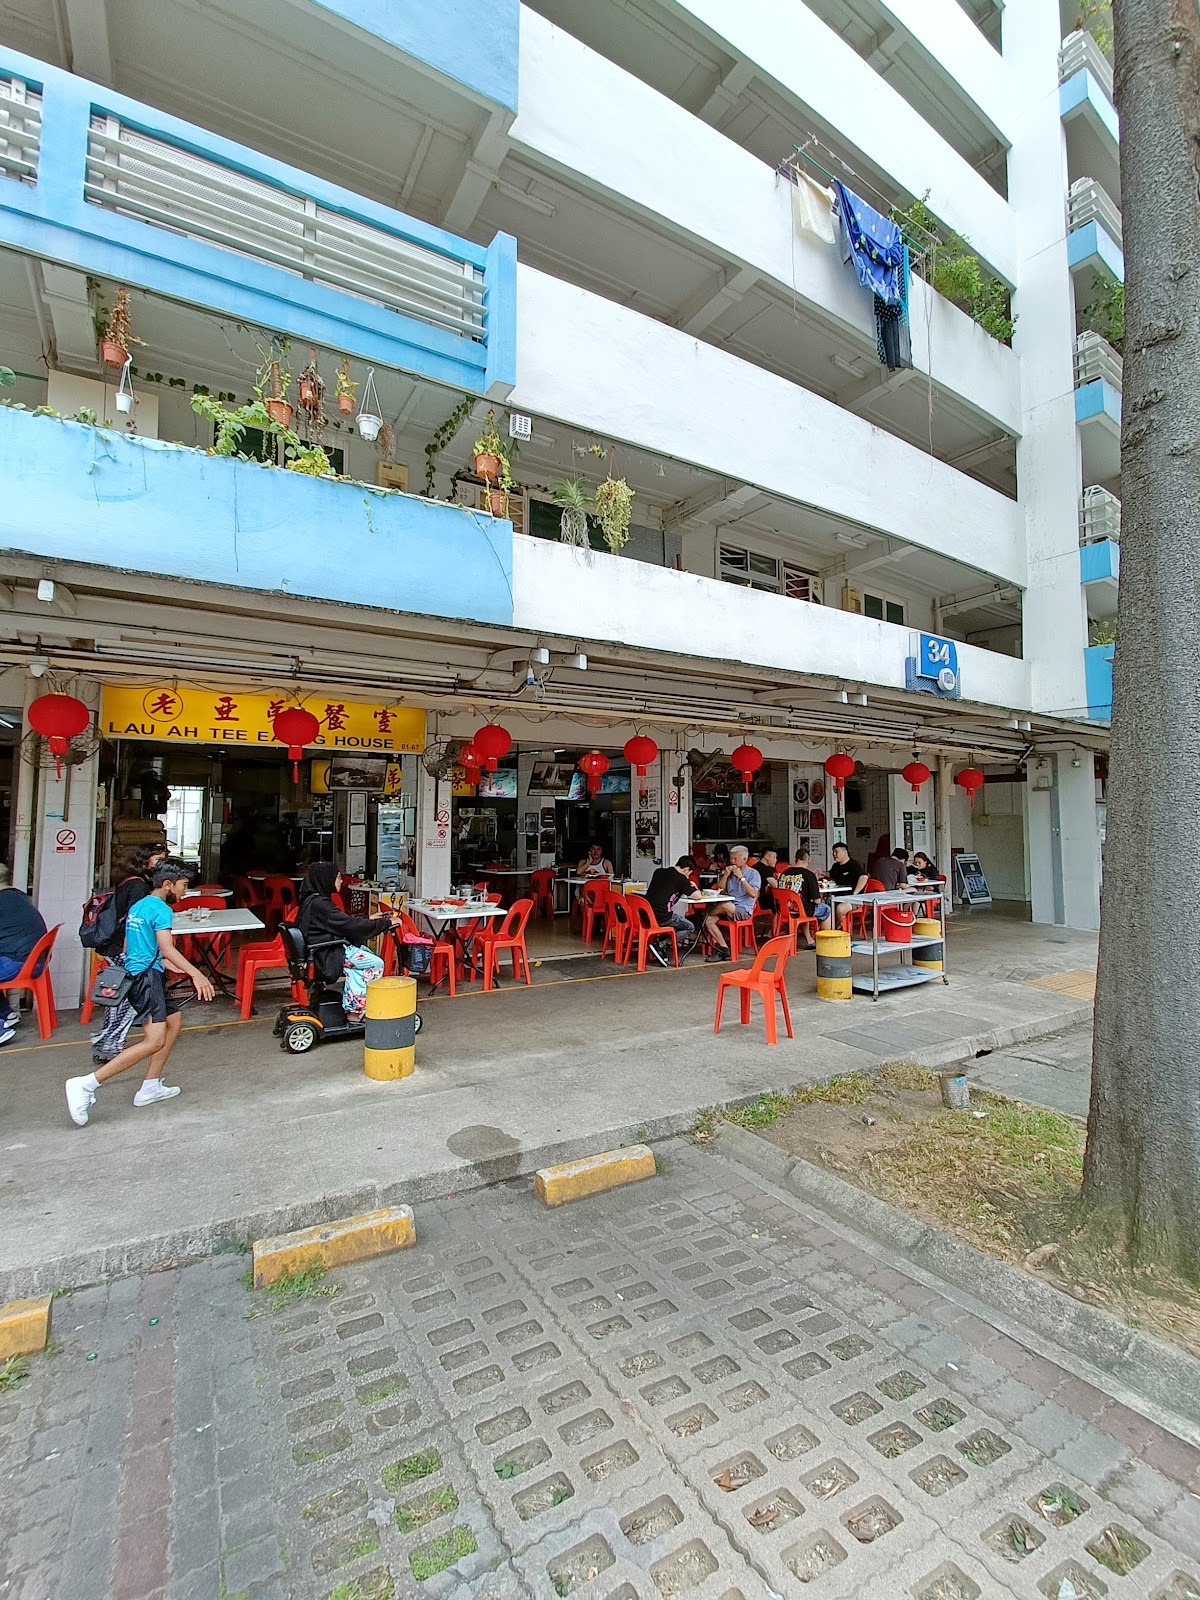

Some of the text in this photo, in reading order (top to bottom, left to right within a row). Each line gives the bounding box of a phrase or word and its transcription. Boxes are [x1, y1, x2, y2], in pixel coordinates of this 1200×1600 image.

[928, 640, 950, 665] 34
[109, 722, 155, 735] LAU
[167, 726, 198, 738] AH
[209, 728, 248, 741] TEE
[335, 736, 394, 749] HOUSE
